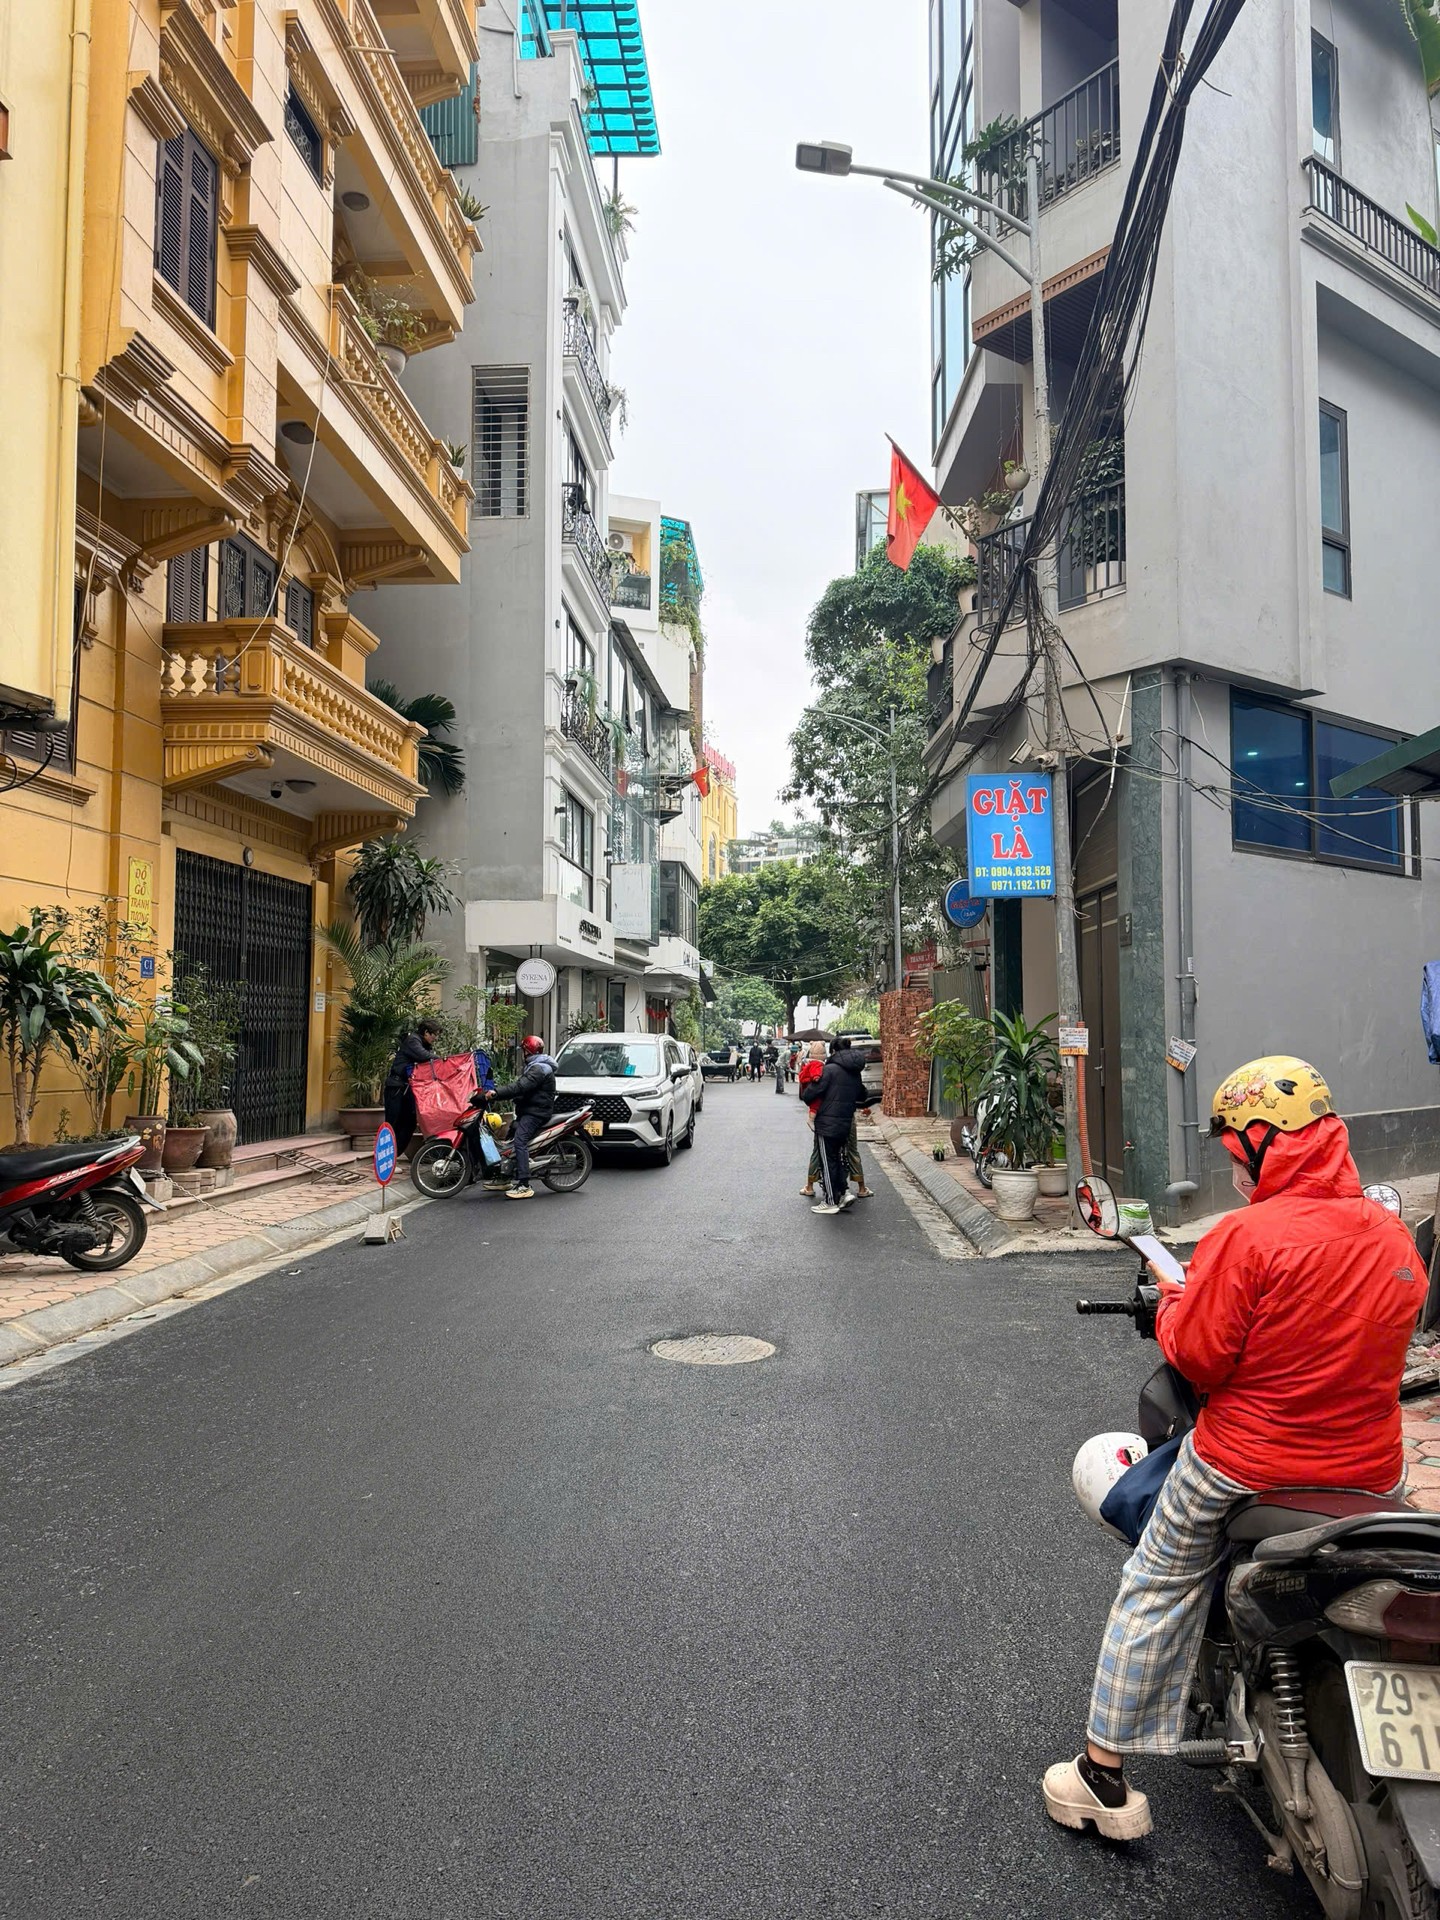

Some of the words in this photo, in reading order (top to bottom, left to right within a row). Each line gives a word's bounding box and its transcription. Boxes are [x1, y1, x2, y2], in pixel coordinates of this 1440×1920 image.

[972, 780, 1049, 822] GIẶT
[991, 825, 1033, 859] LÀ
[991, 865, 1051, 877] 0904.633.528
[991, 879, 1052, 891] 0971.192.167
[130, 898, 150, 909] TRANH
[144, 960, 153, 970] C1
[521, 973, 548, 982] SYRENA
